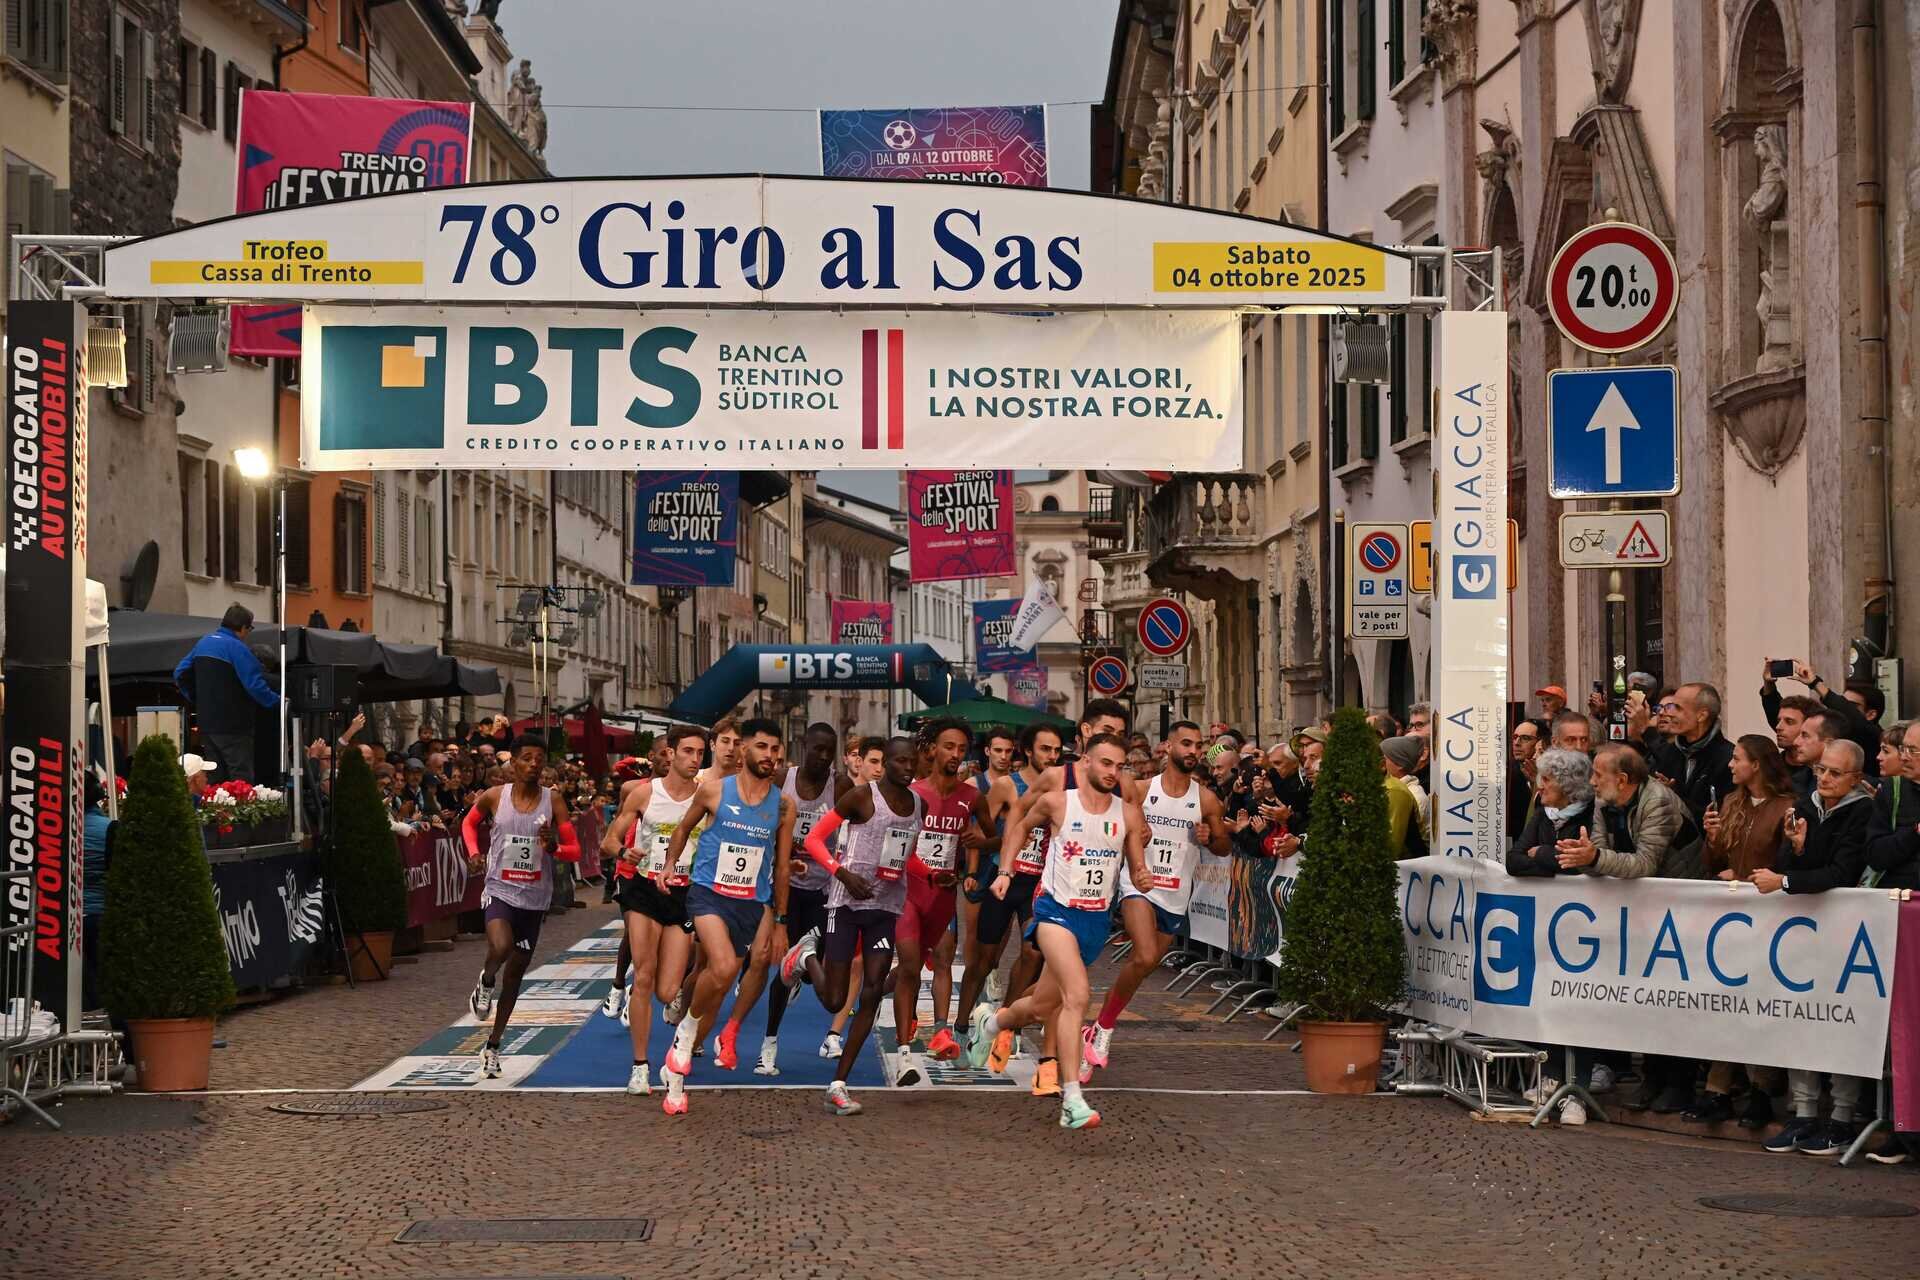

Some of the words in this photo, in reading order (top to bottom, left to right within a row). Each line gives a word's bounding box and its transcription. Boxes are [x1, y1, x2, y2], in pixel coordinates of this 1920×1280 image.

[340, 152, 426, 173] TRENTO
[876, 152, 895, 165] DAL
[897, 152, 910, 165] 09
[912, 152, 924, 164] AL
[926, 151, 939, 164] 12
[942, 150, 993, 163] OTTOBRE
[246, 241, 324, 261] Trofeo
[439, 203, 560, 286] 78°
[578, 200, 786, 290] Giro
[820, 204, 901, 291] al
[932, 208, 1084, 293] Sas
[1227, 245, 1311, 265] Sabato
[201, 264, 264, 282] Cassa
[271, 263, 291, 282] di
[299, 264, 372, 282] Trento
[1172, 268, 1201, 287] 04
[1210, 267, 1299, 287] ottobre
[1308, 268, 1366, 287] 2025
[718, 344, 808, 364] BANCA
[467, 326, 701, 429] BTS
[717, 367, 844, 387] TRENTINO
[929, 368, 936, 389] I
[948, 368, 1061, 390] NOSTRI
[1070, 367, 1192, 394] VALORI,
[717, 387, 839, 411] SÜDTIROL
[929, 397, 970, 419] LA
[975, 396, 1101, 419] NOSTRA
[1112, 397, 1224, 420] FORZA.
[1485, 383, 1497, 448] METALLICA
[13, 346, 39, 510] CECCATO
[41, 338, 67, 560] AUTOMOBILI
[466, 437, 559, 451] CREDITO
[570, 438, 727, 452] COOPERATIVO
[738, 439, 845, 451] ITALIANO
[1454, 383, 1482, 548] GIACCA
[953, 470, 994, 482] TRENTO
[681, 482, 720, 492] TRENTO
[927, 480, 999, 508] FESTIVAL
[655, 491, 722, 515] FESTIVAL
[1485, 459, 1497, 549] CARPENTERIA
[647, 516, 669, 532] dello
[669, 515, 722, 541] SPORT
[921, 509, 944, 527] dello
[944, 504, 999, 533] SPORT
[1359, 610, 1380, 619] vale
[1384, 611, 1401, 622] per
[1360, 622, 1368, 630] 2
[1373, 621, 1399, 631] posti
[842, 622, 884, 636] FESTIVAL
[794, 653, 854, 679] BTS
[1477, 706, 1489, 778] ELETTRICHE
[9, 746, 36, 911] CECCATO
[800, 822, 811, 835] 5
[925, 814, 964, 830] OLIZIA
[1146, 814, 1194, 829] ESERCITO
[1477, 782, 1489, 859] OSTRUZIONI
[36, 738, 63, 960] AUTOMOBILI
[901, 842, 906, 857] 1
[932, 843, 943, 858] 2
[1160, 839, 1172, 847] BTS
[520, 847, 530, 860] 3
[1159, 849, 1172, 864] 11
[735, 857, 747, 872] 9
[1085, 869, 1104, 885] 13
[1548, 902, 1887, 998] GIACCA
[1417, 946, 1469, 981] ELETTRICHE
[1550, 980, 1630, 1003] DIVISIONE
[1633, 987, 1750, 1015] CARPENTERIA
[1757, 997, 1856, 1024] METALLICA
